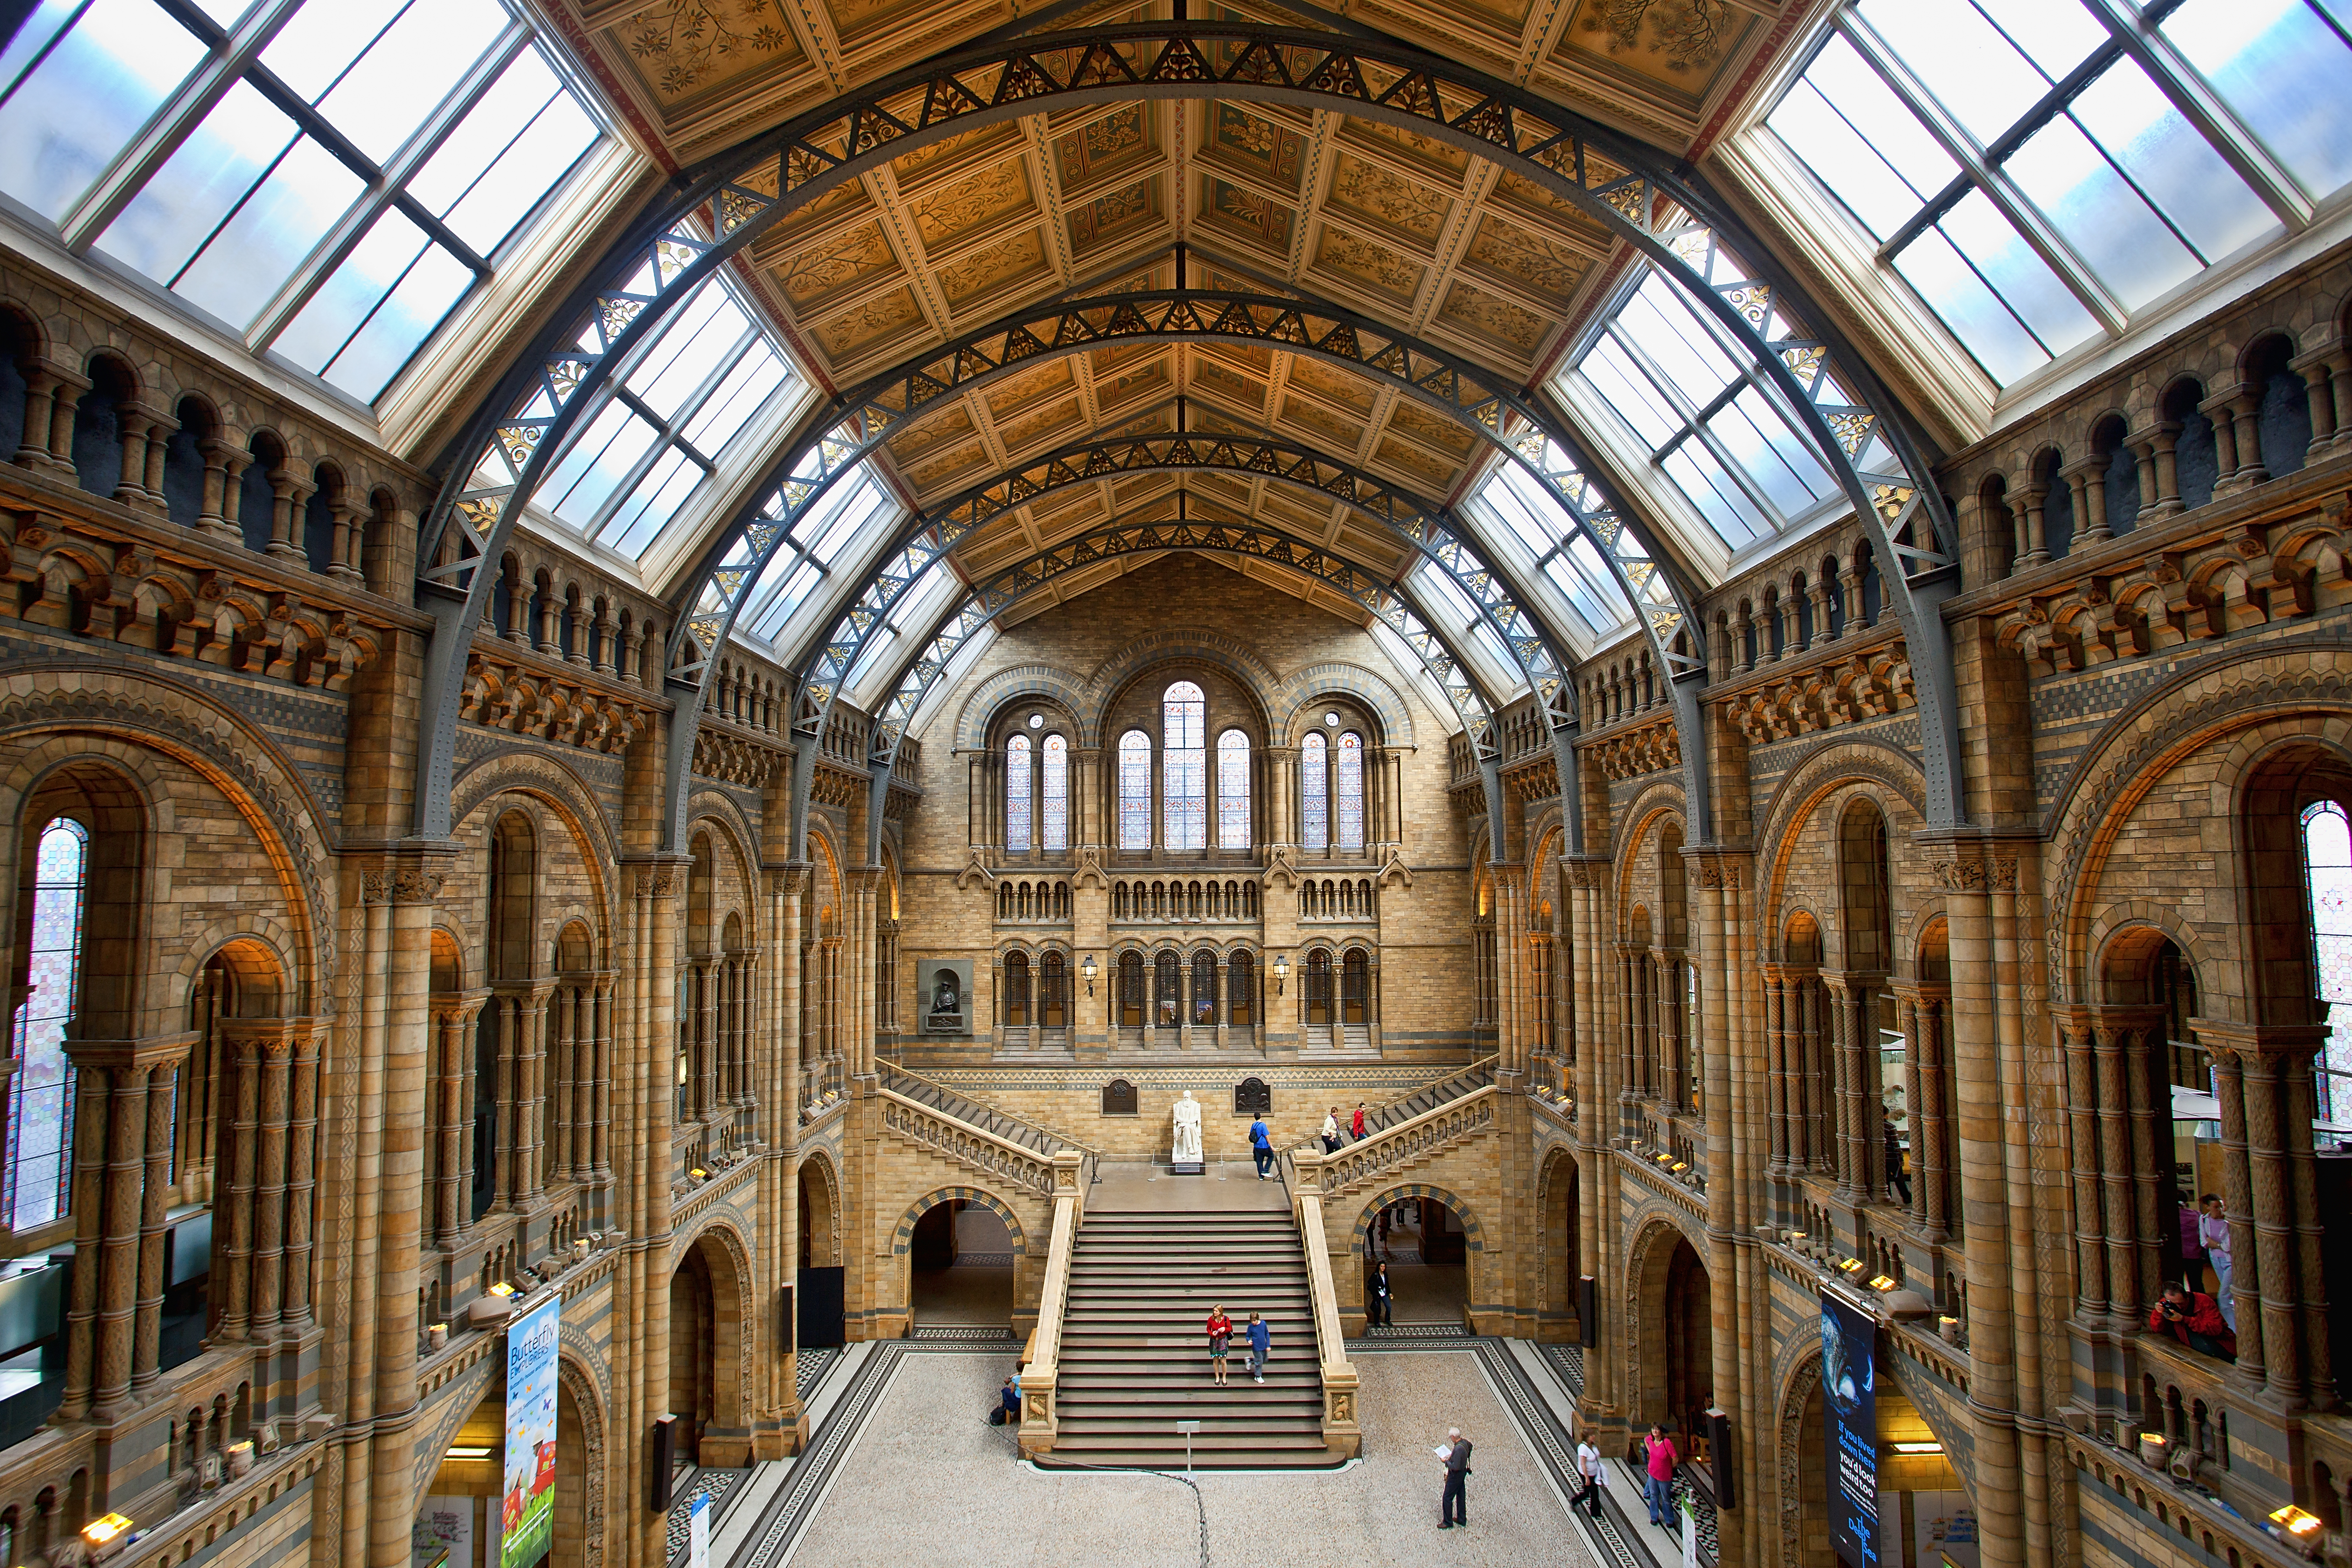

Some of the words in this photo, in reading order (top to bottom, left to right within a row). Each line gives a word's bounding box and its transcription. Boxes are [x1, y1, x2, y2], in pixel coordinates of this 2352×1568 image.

[510, 1343, 549, 1379] EXPLORERS
[511, 1323, 555, 1366] Butterfly
[1838, 1419, 1844, 1433] If
[1844, 1427, 1857, 1444] you
[1858, 1435, 1875, 1459] lived
[1839, 1434, 1857, 1458] down
[1858, 1449, 1875, 1472] here
[1840, 1463, 1859, 1487] weird
[1859, 1479, 1873, 1498] too
[1859, 1464, 1875, 1488] look
[1856, 1516, 1870, 1539] The
[1863, 1542, 1876, 1563] Sea
